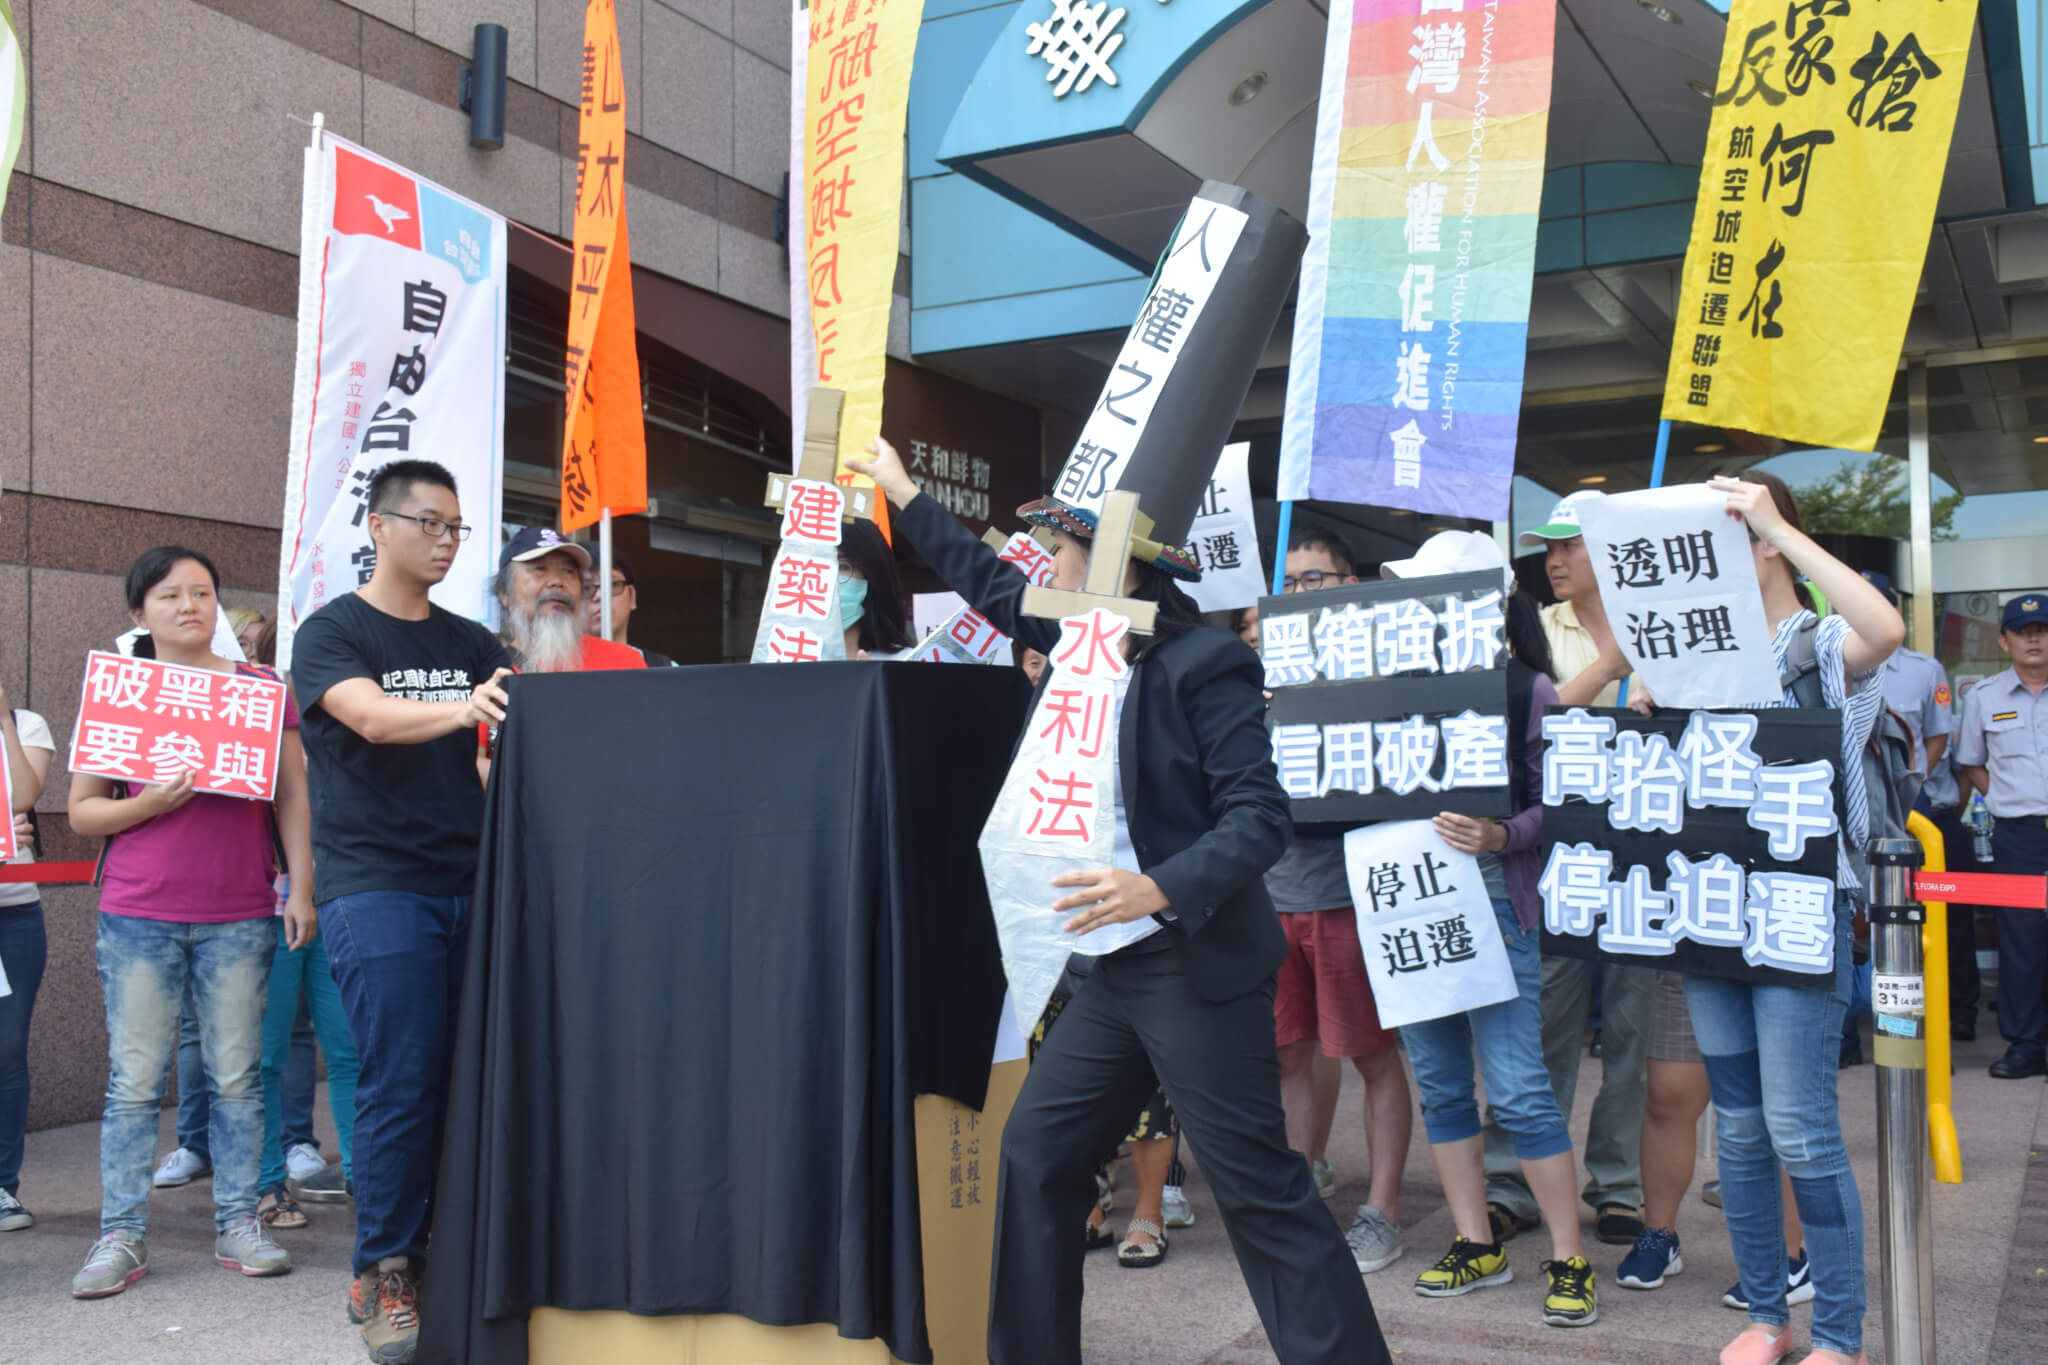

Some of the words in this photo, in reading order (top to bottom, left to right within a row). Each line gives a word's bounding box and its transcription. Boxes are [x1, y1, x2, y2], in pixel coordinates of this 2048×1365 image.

[1461, 89, 1491, 224] ASSOCIATION
[1456, 230, 1473, 268] FOR
[1446, 276, 1469, 357] HUMAN
[1060, 207, 1217, 503] 人權之都
[1441, 362, 1460, 431] RIGHTS
[909, 439, 991, 490] 天和鮮物
[1607, 530, 1720, 590] 透明
[1261, 590, 1506, 688] 黑箱強拆
[1627, 603, 1741, 660] 治理
[89, 657, 277, 732] 破黑箱
[1026, 611, 1124, 842] 水利法
[78, 720, 267, 796] 要參與
[1271, 709, 1510, 800] 信用破產
[1542, 708, 1838, 861] 高抬怪手
[1366, 852, 1457, 912] 停止
[1538, 842, 1836, 975] 停止迫遷
[1380, 913, 1478, 978] 迫遷
